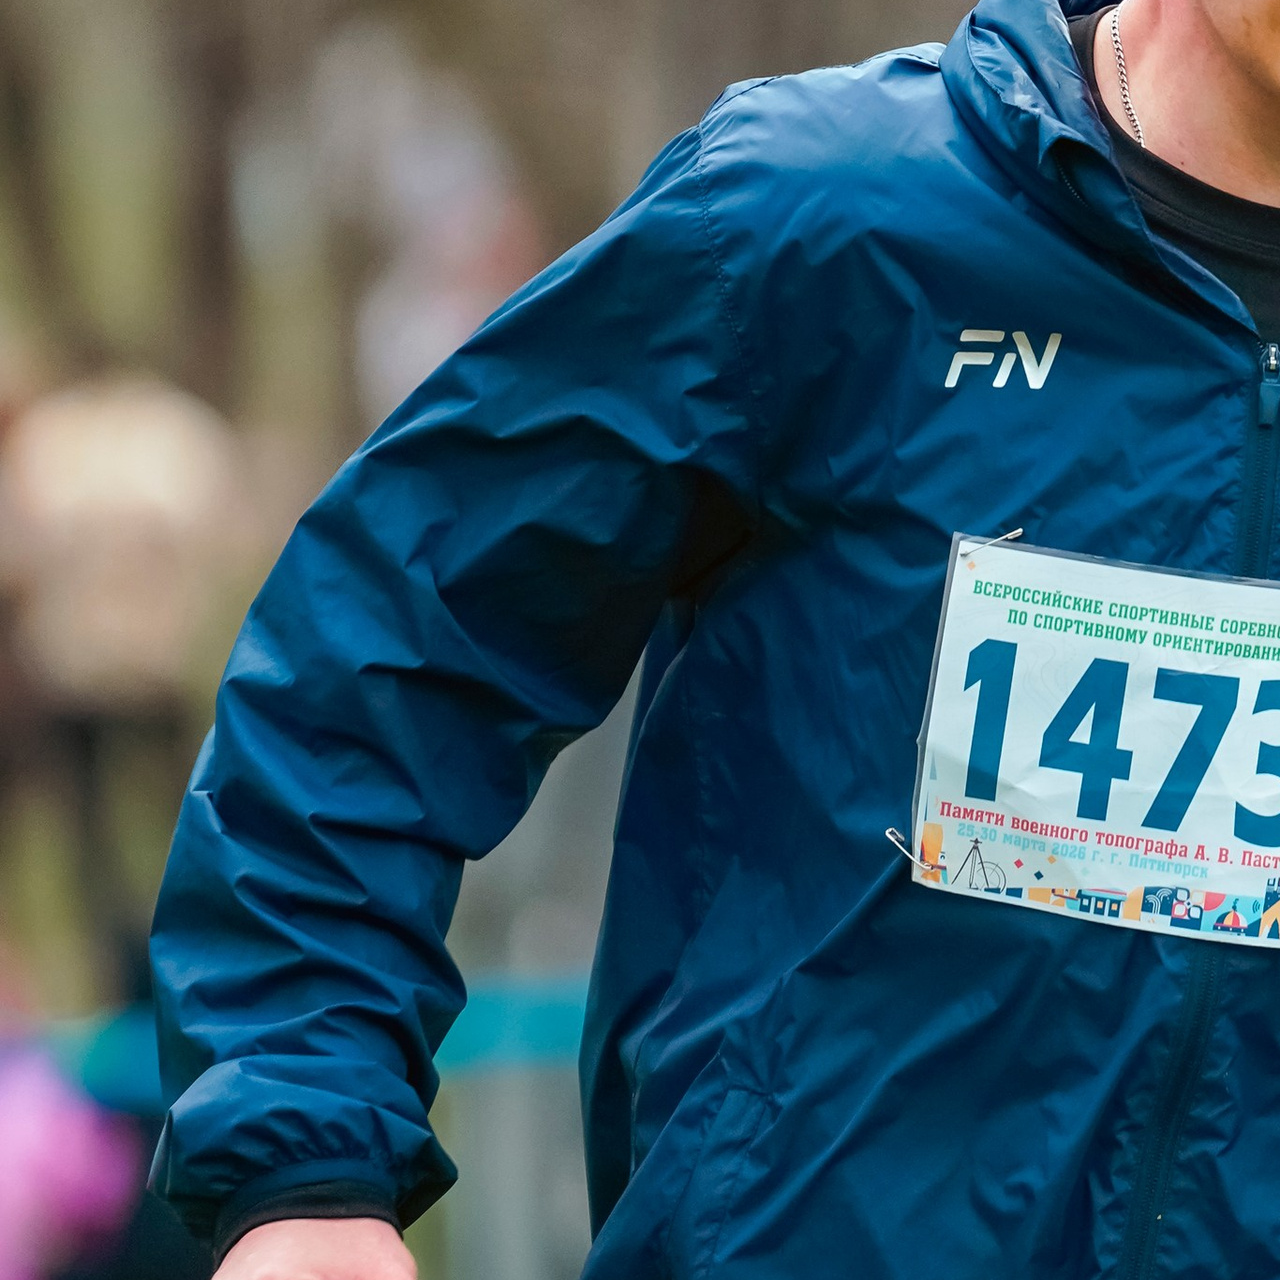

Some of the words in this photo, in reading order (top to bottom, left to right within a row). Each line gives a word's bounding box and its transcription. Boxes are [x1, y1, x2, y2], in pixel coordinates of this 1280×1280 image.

[973, 579, 1103, 615] ВСЕРОССИЙСКИЕ
[1108, 602, 1215, 631] СПОРТИВНЫЕ
[1007, 609, 1028, 626] ПО
[1033, 613, 1148, 645] СПОРТИВНОМУ
[939, 801, 1005, 827] Памяти
[1010, 816, 1089, 843] военного
[1095, 831, 1188, 859] топографа
[1193, 844, 1210, 861] А.
[1217, 847, 1233, 864] В.
[957, 822, 997, 842] 25-30
[1002, 832, 1046, 853] марта
[1051, 842, 1087, 860] 2026
[1091, 849, 1104, 863] г.
[1109, 852, 1122, 866] г.
[1128, 853, 1209, 879] Пятигорск
